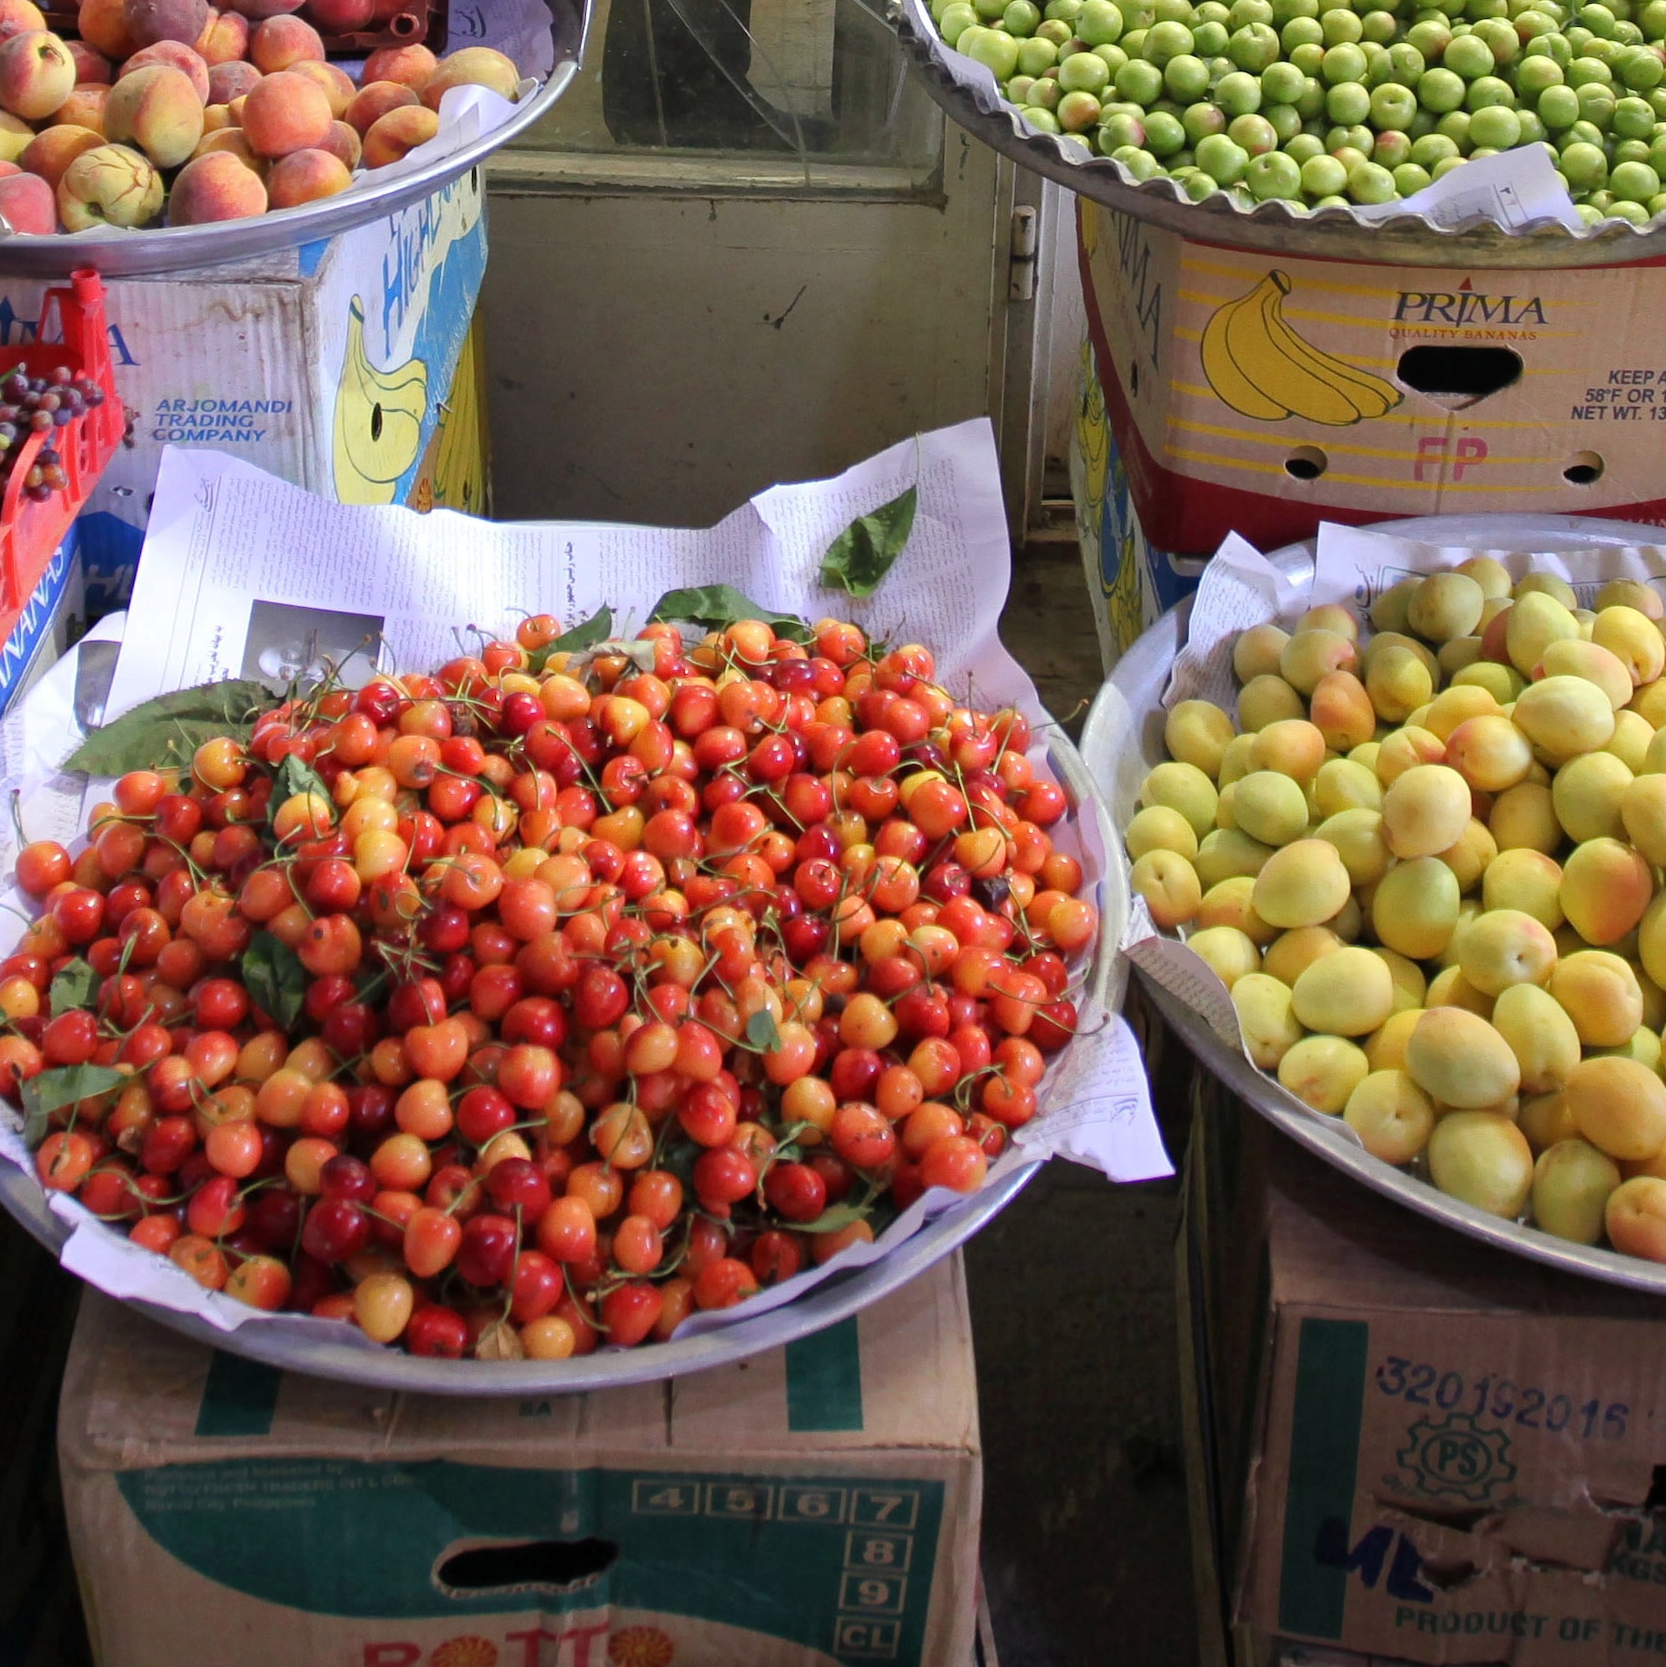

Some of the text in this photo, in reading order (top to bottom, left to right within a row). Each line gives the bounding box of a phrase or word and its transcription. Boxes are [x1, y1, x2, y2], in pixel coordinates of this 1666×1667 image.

[1392, 290, 1550, 328] PRIMA
[1388, 327, 1538, 342] QUALITY BANANAS
[1608, 370, 1655, 385] KEEP
[155, 398, 294, 414] ARJOMANDI
[1584, 388, 1621, 403] 58°F
[1627, 388, 1655, 404] OR
[154, 413, 255, 429] TRADING
[1570, 405, 1608, 421] NET
[1612, 406, 1642, 421] WT.
[151, 428, 267, 443] COMPANY
[1437, 1438, 1480, 1477] PS
[648, 1487, 903, 1522] 4 5 6 7
[862, 1539, 896, 1565] 8
[857, 1578, 889, 1606] 9
[1395, 1606, 1550, 1639] PRODUCT
[1558, 1617, 1603, 1642] OF
[841, 1623, 896, 1650] CL
